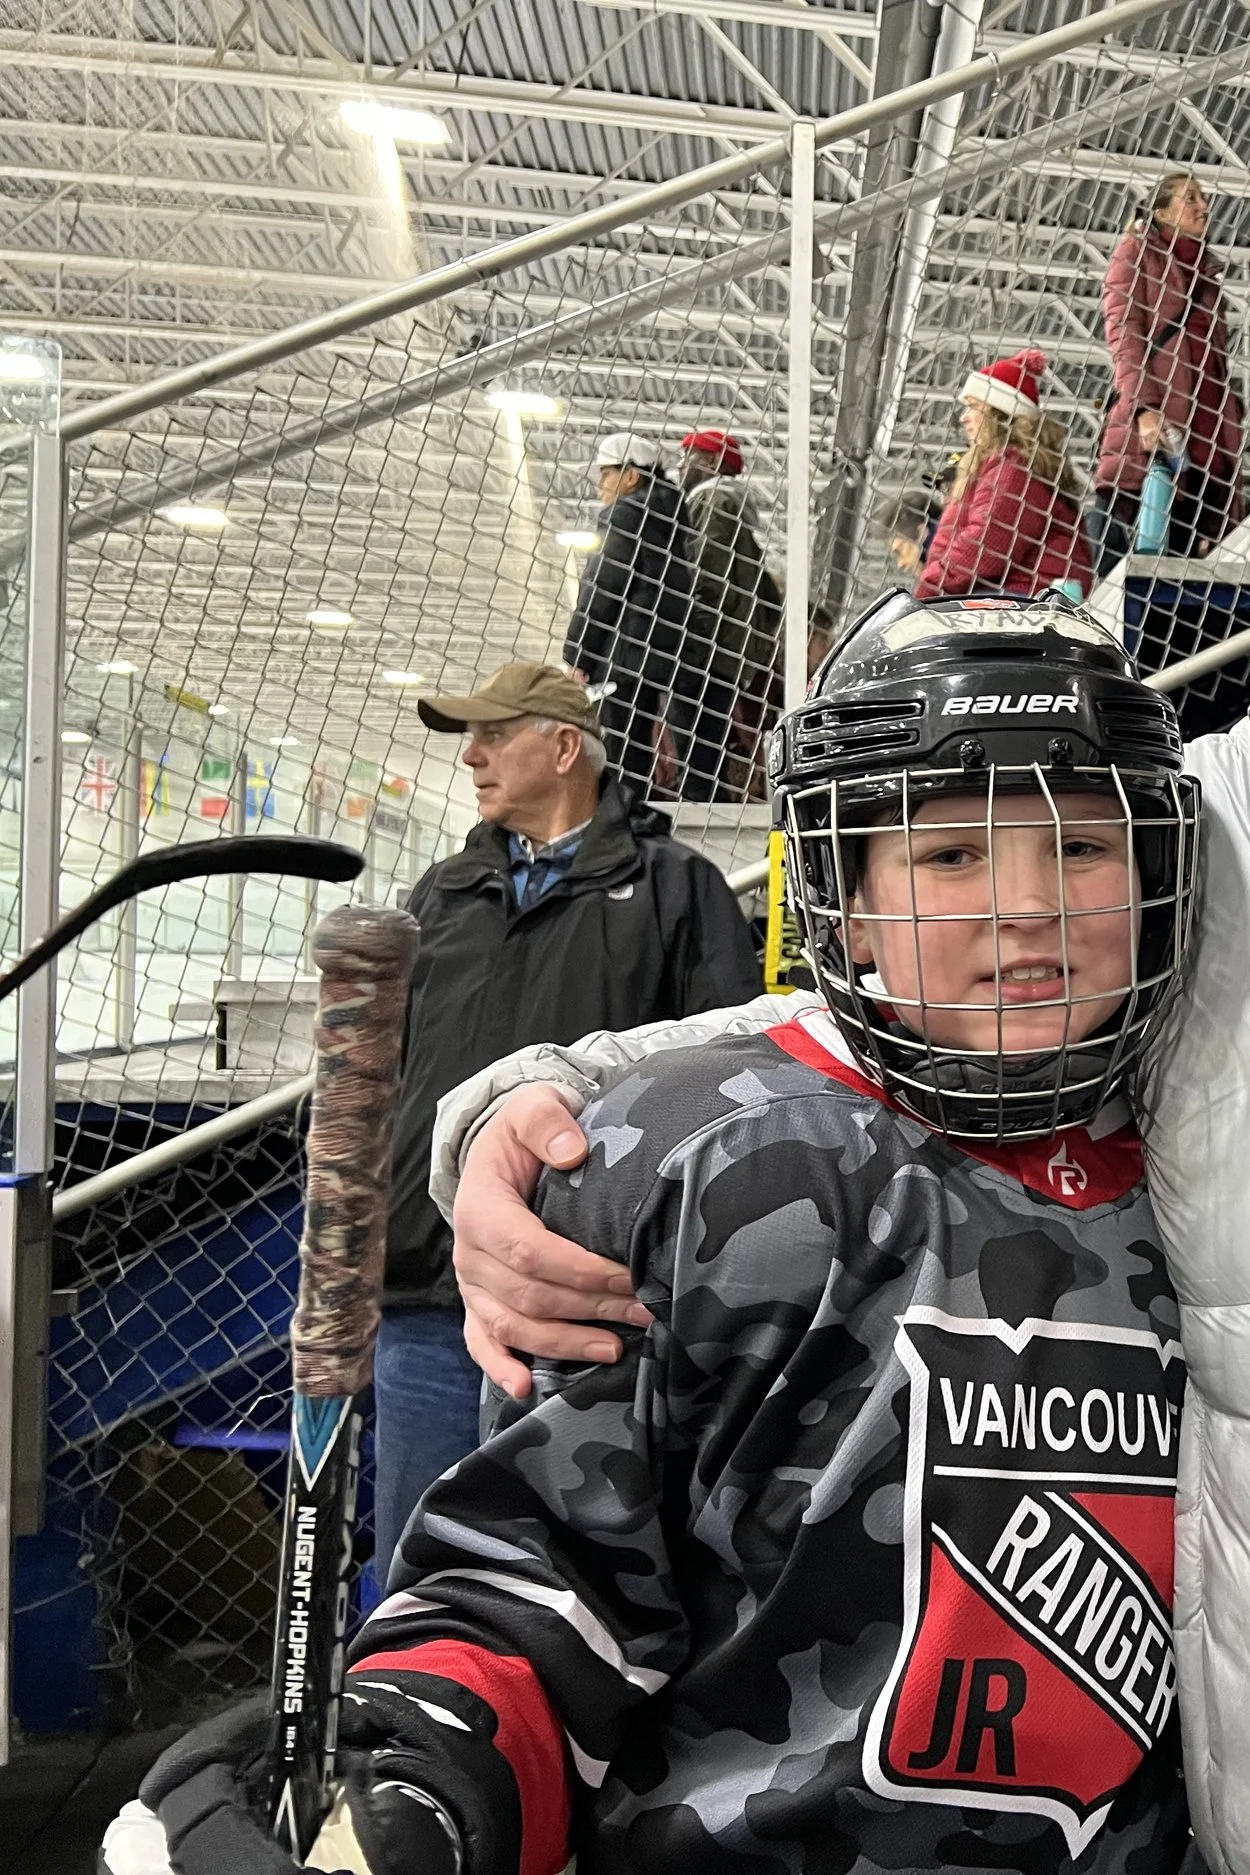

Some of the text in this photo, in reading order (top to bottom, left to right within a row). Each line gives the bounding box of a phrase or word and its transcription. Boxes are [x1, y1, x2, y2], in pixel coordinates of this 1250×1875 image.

[941, 694, 1080, 715] BAUER
[939, 1377, 1178, 1457] VANCOUV
[284, 1506, 318, 1714] NUGENT-HOPKINS
[907, 1657, 1028, 1777] JR
